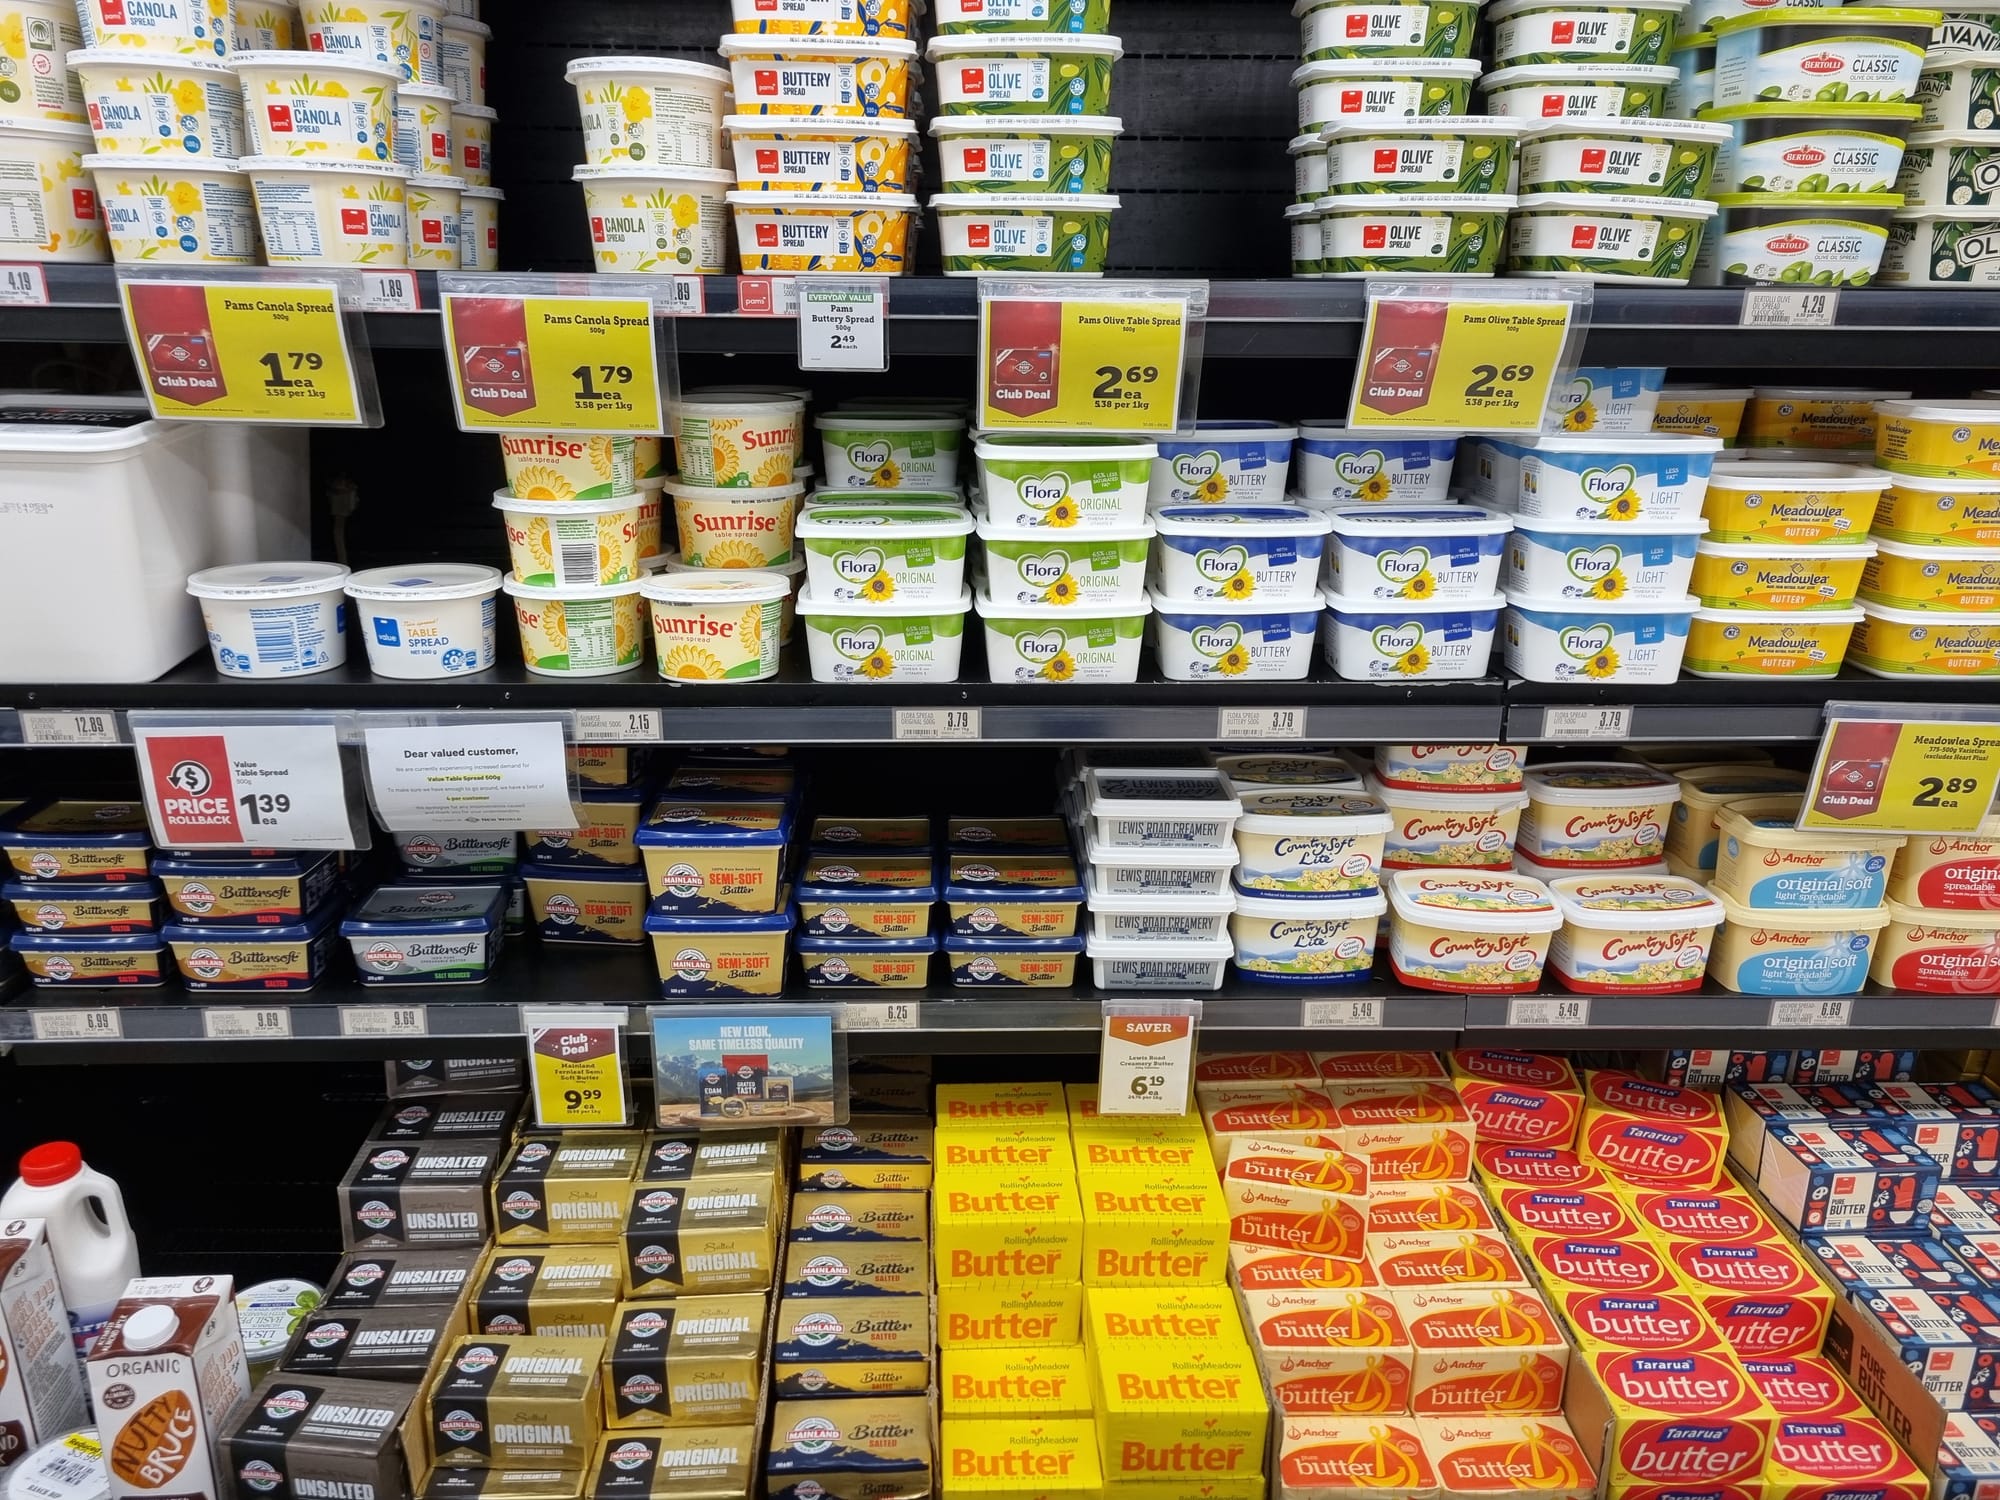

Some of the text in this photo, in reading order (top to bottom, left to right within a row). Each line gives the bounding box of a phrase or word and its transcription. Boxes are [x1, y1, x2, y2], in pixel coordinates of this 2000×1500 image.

[128, 2, 177, 19] CANOLA
[1372, 15, 1401, 29] OLIVE
[1852, 59, 1900, 73] CLASSIC
[989, 90, 1010, 98] SPREAD
[1609, 150, 1642, 167] OLIVE
[783, 239, 804, 247] SPREAD
[1769, 241, 1806, 250] BERTOLLI
[8, 271, 31, 291] 4.19
[379, 279, 402, 297] 1.89
[808, 293, 873, 302] EVERYDAY VALUE
[225, 301, 334, 314] Pams Canola Spread
[831, 304, 853, 313] Pams
[1800, 295, 1825, 313] 4.29
[272, 313, 289, 321] 500g
[544, 314, 649, 327] Pams Canola Spread
[812, 315, 875, 325] Buttery Spread
[1079, 316, 1181, 328] Pams Olive Table Spread
[1464, 315, 1566, 328] Pams Olive Table Spread
[159, 376, 217, 388] Club Deal
[294, 378, 313, 388] ea
[265, 389, 326, 399] 3.58 per 1kg
[471, 388, 527, 398] Club Deal
[603, 390, 622, 400] ea
[996, 389, 1051, 399] Club Deal
[1124, 390, 1142, 399] ea
[1369, 387, 1423, 397] Club Deal
[1496, 388, 1513, 398] ea
[575, 401, 633, 411] 3.58 per 1kg
[1114, 402, 1130, 411] per
[1132, 401, 1149, 410] 1kg
[901, 462, 936, 473] ORIGINAL
[1392, 473, 1430, 485] BUTTERY
[1650, 491, 1680, 505] LIGHT
[1771, 504, 1842, 517] Meadowlea
[1204, 559, 1238, 571] Flora
[1770, 593, 1805, 604] BUTTERY
[655, 615, 733, 639] Sunrise
[378, 633, 397, 642] value
[74, 717, 104, 733] 12.89
[629, 713, 650, 730] 2.15
[947, 711, 968, 727] 3.79
[1273, 711, 1293, 727] 3.79
[1600, 711, 1622, 728] 3.79
[1914, 736, 2000, 748] Meadowlea Sprea
[404, 747, 518, 759] Dear valued customer,
[234, 761, 257, 769] Value
[260, 769, 289, 778] Spread
[165, 798, 229, 814] PRICE
[1822, 796, 1873, 805] Club Deal
[1941, 800, 1958, 808] ea
[168, 815, 232, 825] ROLLBACK
[262, 816, 278, 825] ea
[1118, 822, 1218, 836] LEWIS ROAD CREAMERY
[1299, 851, 1330, 865] Lite
[219, 886, 291, 899] Buttersoft
[873, 913, 916, 924] SEMI-SOFT
[671, 960, 711, 970] MAINLAND
[1764, 955, 1857, 970] original soft
[1918, 968, 1969, 977] spreadable
[888, 1006, 908, 1019] 6.25
[1352, 1002, 1372, 1017] 5.49
[1558, 1002, 1579, 1017] 5.49
[1820, 1002, 1841, 1016] 6.69
[87, 1013, 109, 1028] 6.99
[257, 1013, 279, 1027] 9.69
[394, 1011, 416, 1027] 9.69
[720, 1026, 771, 1038] NEW LOOK,
[1126, 1023, 1172, 1033] SAVER
[560, 1033, 588, 1046] Club
[689, 1037, 804, 1052] SAME TIMELESS QUALITY
[562, 1043, 588, 1056] Deal
[736, 1086, 757, 1095] TASTY
[1371, 1134, 1404, 1144] Anchor
[1628, 1127, 1679, 1144] Tararua
[559, 1148, 626, 1162] ORIGINAL
[1829, 1204, 1866, 1215] BUTTER
[952, 1249, 1061, 1277] Butter
[107, 1359, 180, 1378] ORGANIC
[1924, 1381, 1963, 1392] BUTTER
[1432, 1385, 1506, 1406] butter
[311, 1404, 394, 1427] UNSALTED
[140, 1407, 193, 1484] BRUCE
